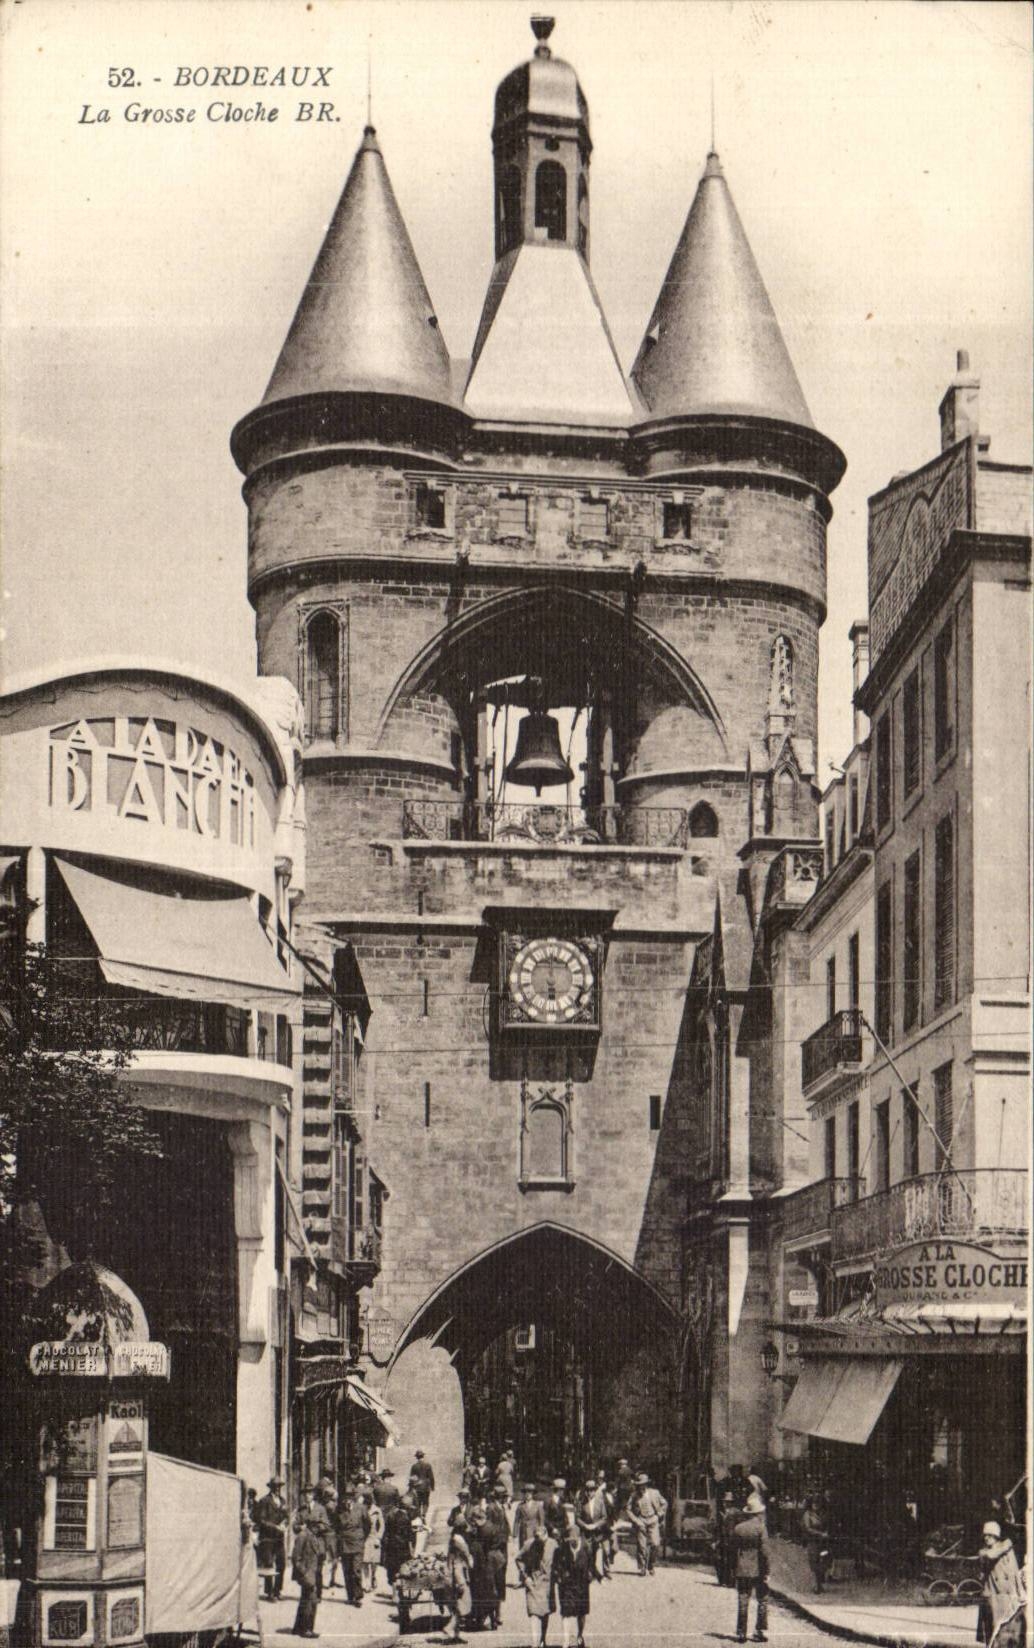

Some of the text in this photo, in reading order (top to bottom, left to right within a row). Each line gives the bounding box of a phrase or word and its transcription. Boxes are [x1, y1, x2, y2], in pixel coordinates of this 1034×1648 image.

[66, 717, 254, 790] A LA DAME
[52, 748, 257, 849] BLANCHE
[918, 1244, 957, 1262] A LA
[876, 1264, 938, 1290] GROSSE
[37, 1345, 100, 1358] CHOCOLAT
[39, 1359, 98, 1372] MENIER
